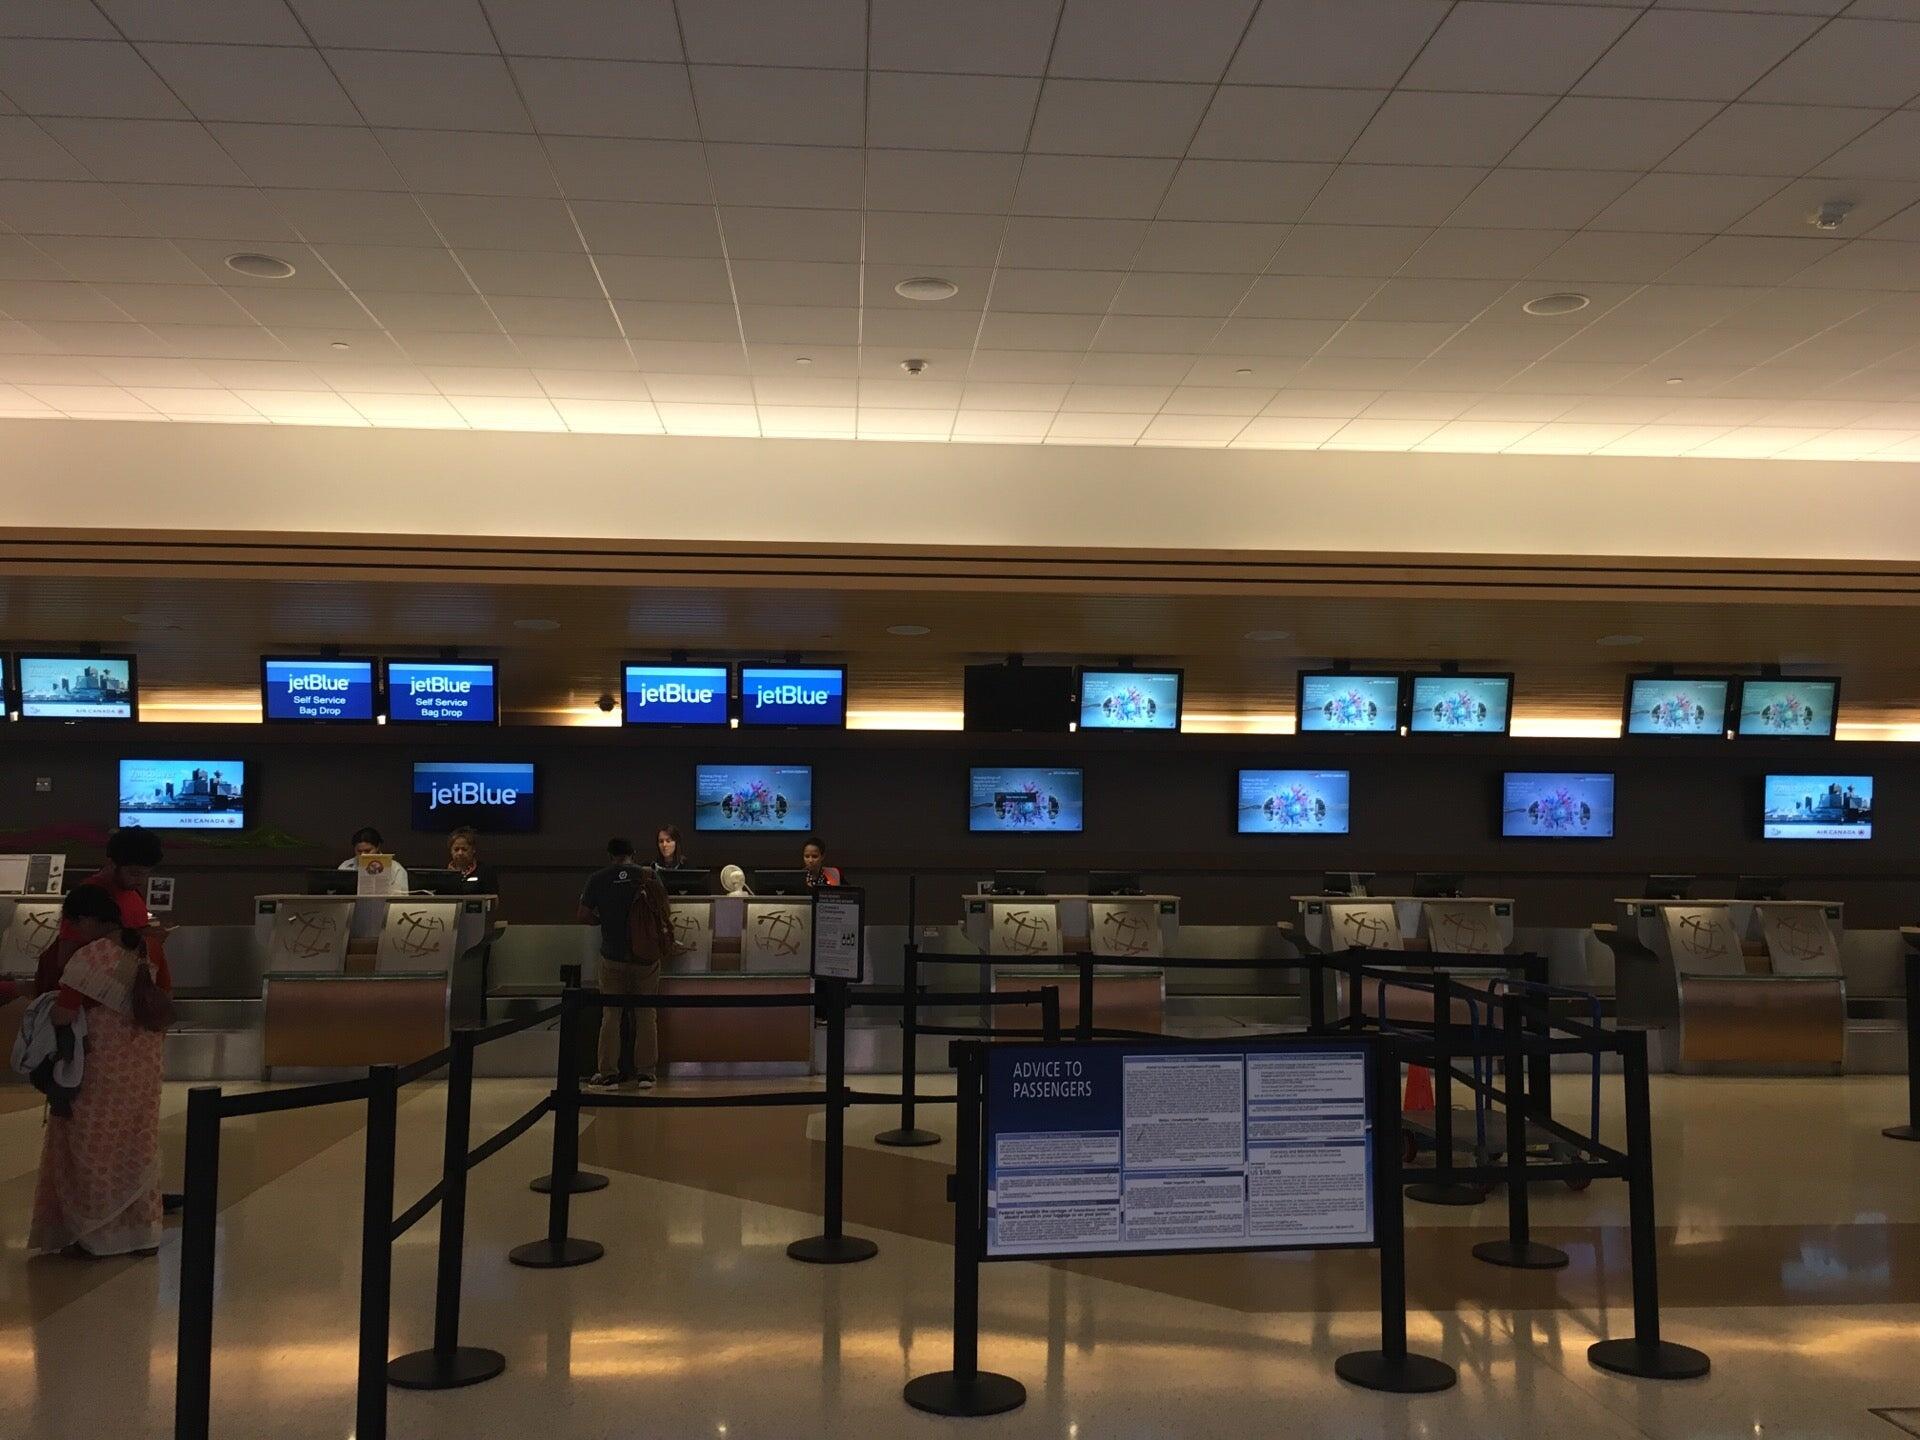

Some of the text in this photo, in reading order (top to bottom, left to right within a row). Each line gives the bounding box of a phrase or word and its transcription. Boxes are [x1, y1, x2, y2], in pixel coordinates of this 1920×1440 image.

[288, 673, 349, 693] jetBlue
[410, 676, 471, 696] jetBlue
[293, 695, 346, 705] Self Service
[415, 697, 468, 707] Self Service
[639, 682, 713, 707] jetBlue
[755, 685, 829, 709] jetBlue
[299, 707, 341, 716] Bag Drop
[421, 709, 463, 718] Bag Drop
[429, 781, 517, 810] jetBlue
[1012, 1060, 1082, 1078] ADVICE TO
[1013, 1081, 1092, 1098] PASSENGERS
